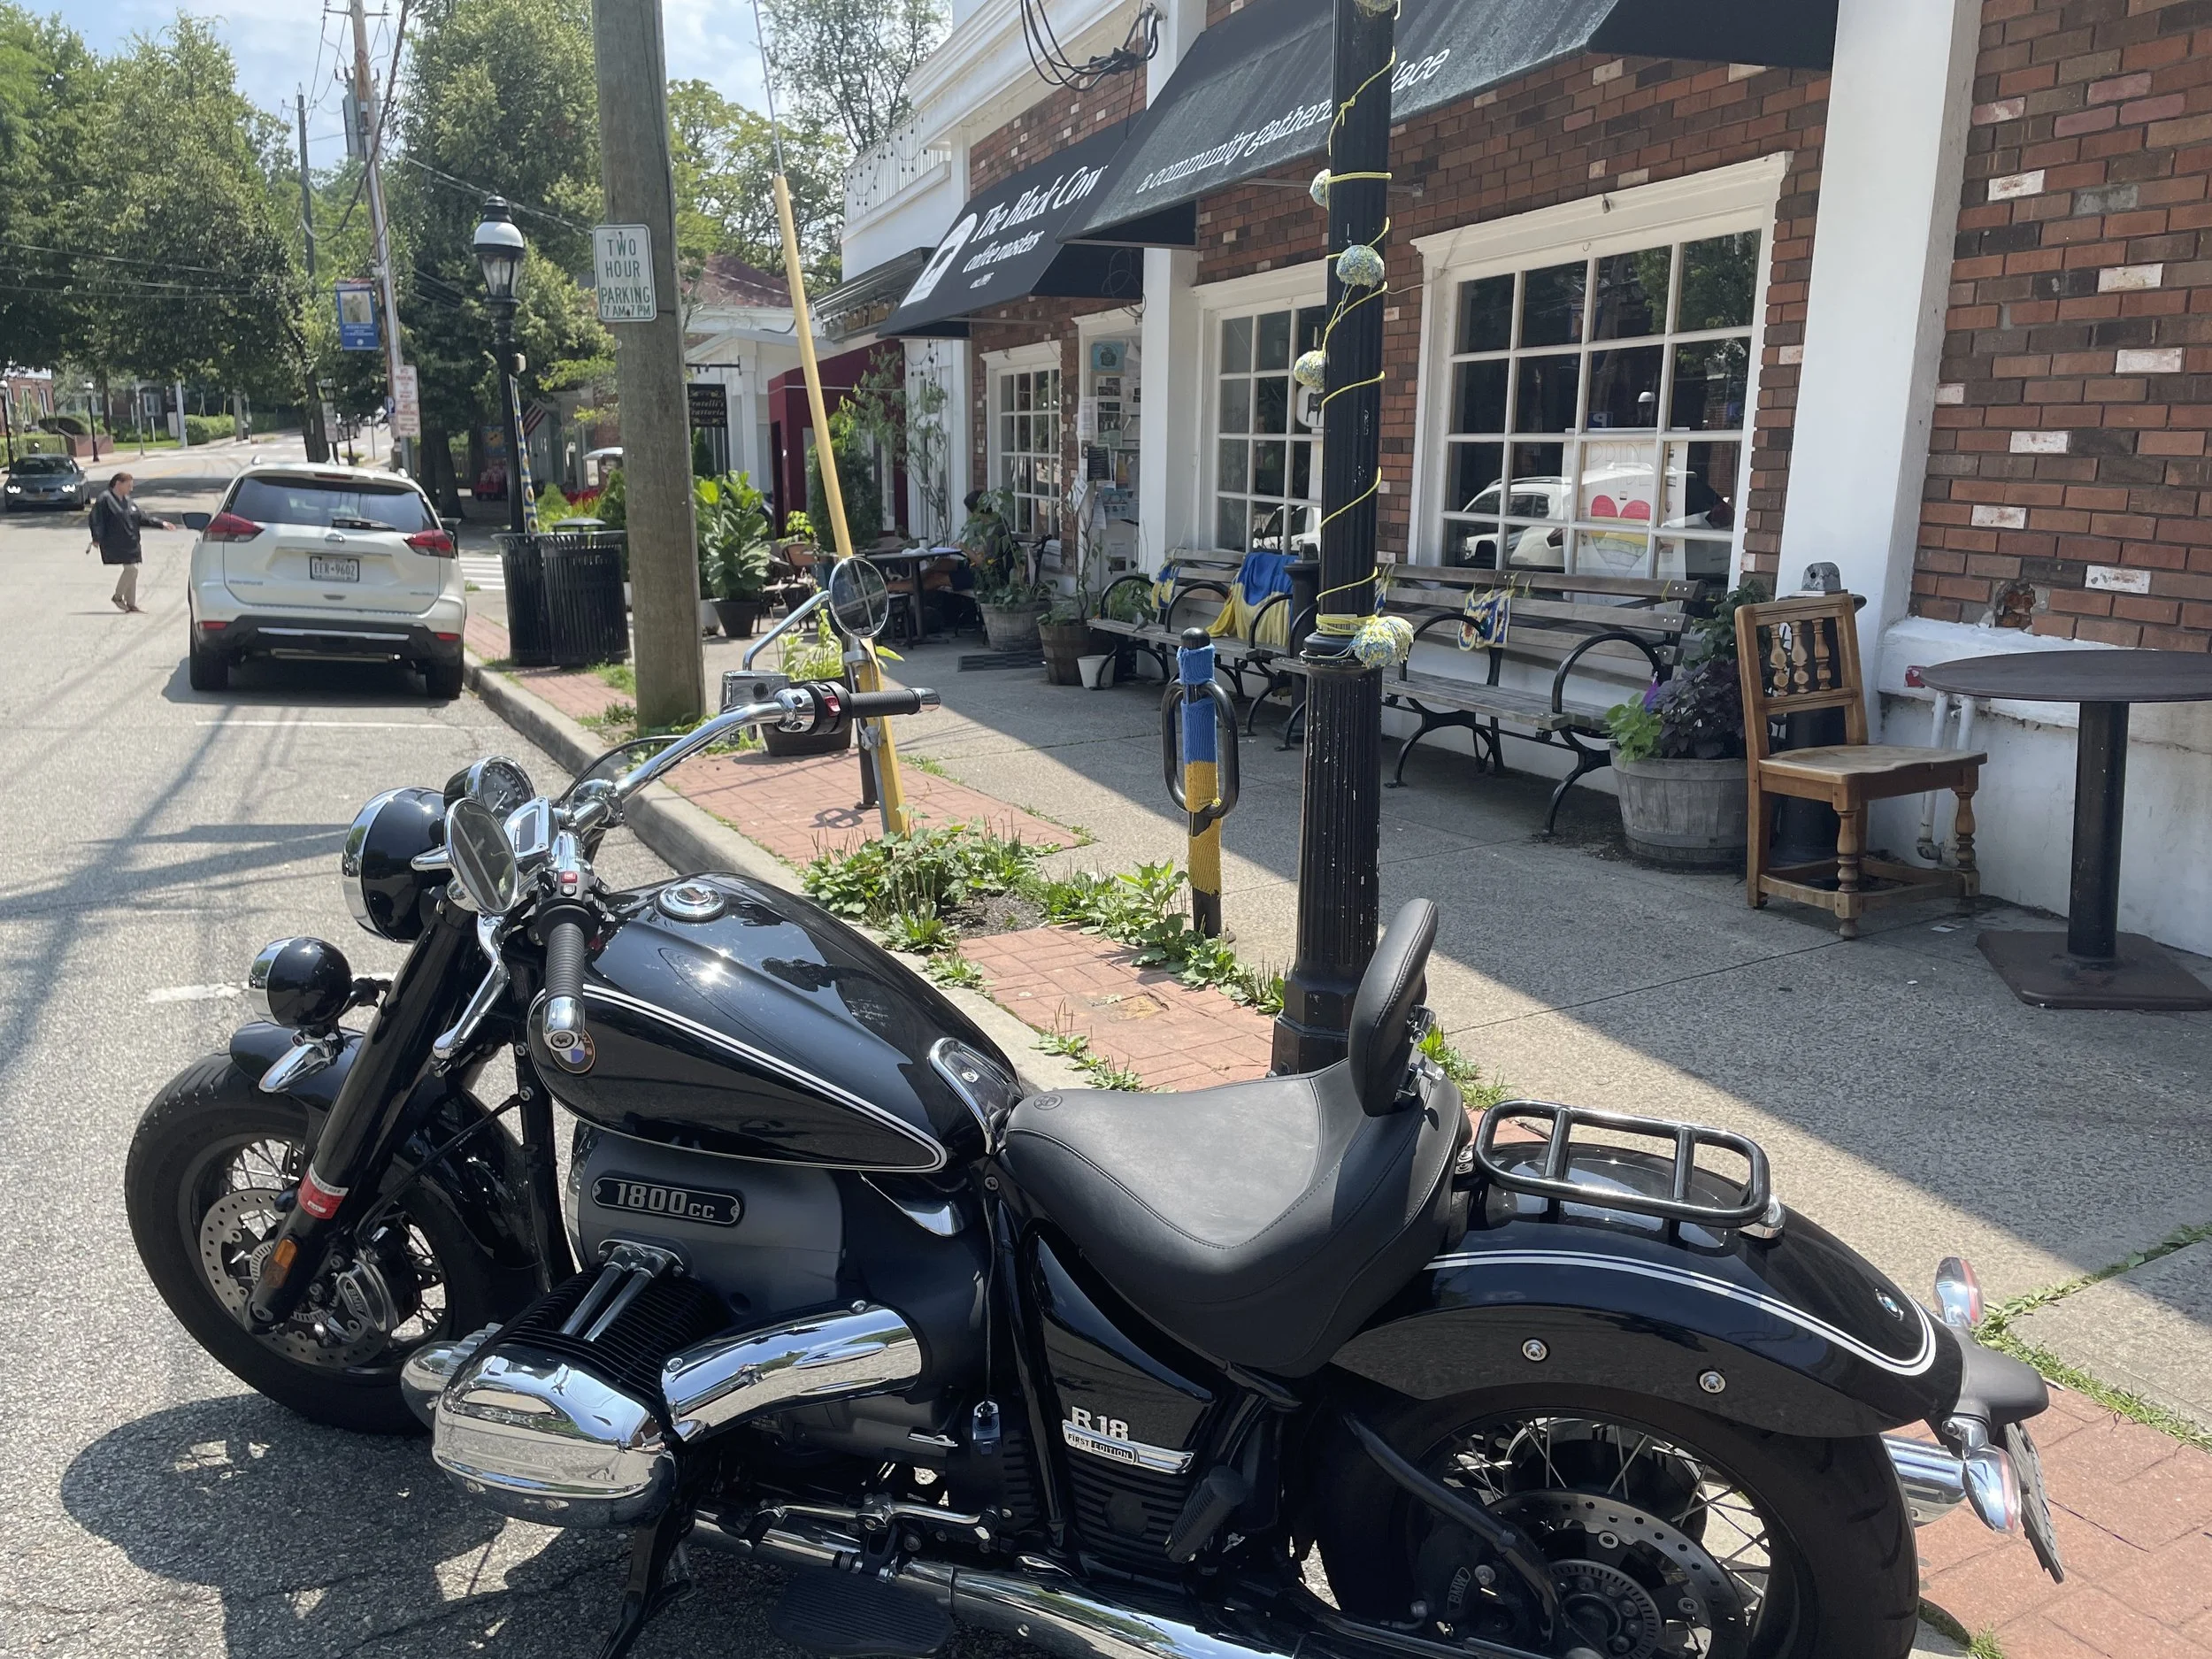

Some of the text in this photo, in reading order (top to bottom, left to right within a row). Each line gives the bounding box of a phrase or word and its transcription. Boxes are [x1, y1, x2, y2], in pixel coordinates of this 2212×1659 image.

[1135, 173, 1154, 194] a
[1148, 131, 1257, 189] community
[1390, 48, 1451, 94] lace
[970, 165, 1109, 243] The Black Cow
[606, 237, 637, 257] TWO
[962, 230, 1046, 274] coffee roasters
[604, 260, 641, 279] HOUR
[601, 286, 651, 304] PARKING
[637, 304, 651, 317] PM
[617, 1183, 716, 1219] 1800cc
[1068, 1433, 1129, 1458] FIRST EDITION
